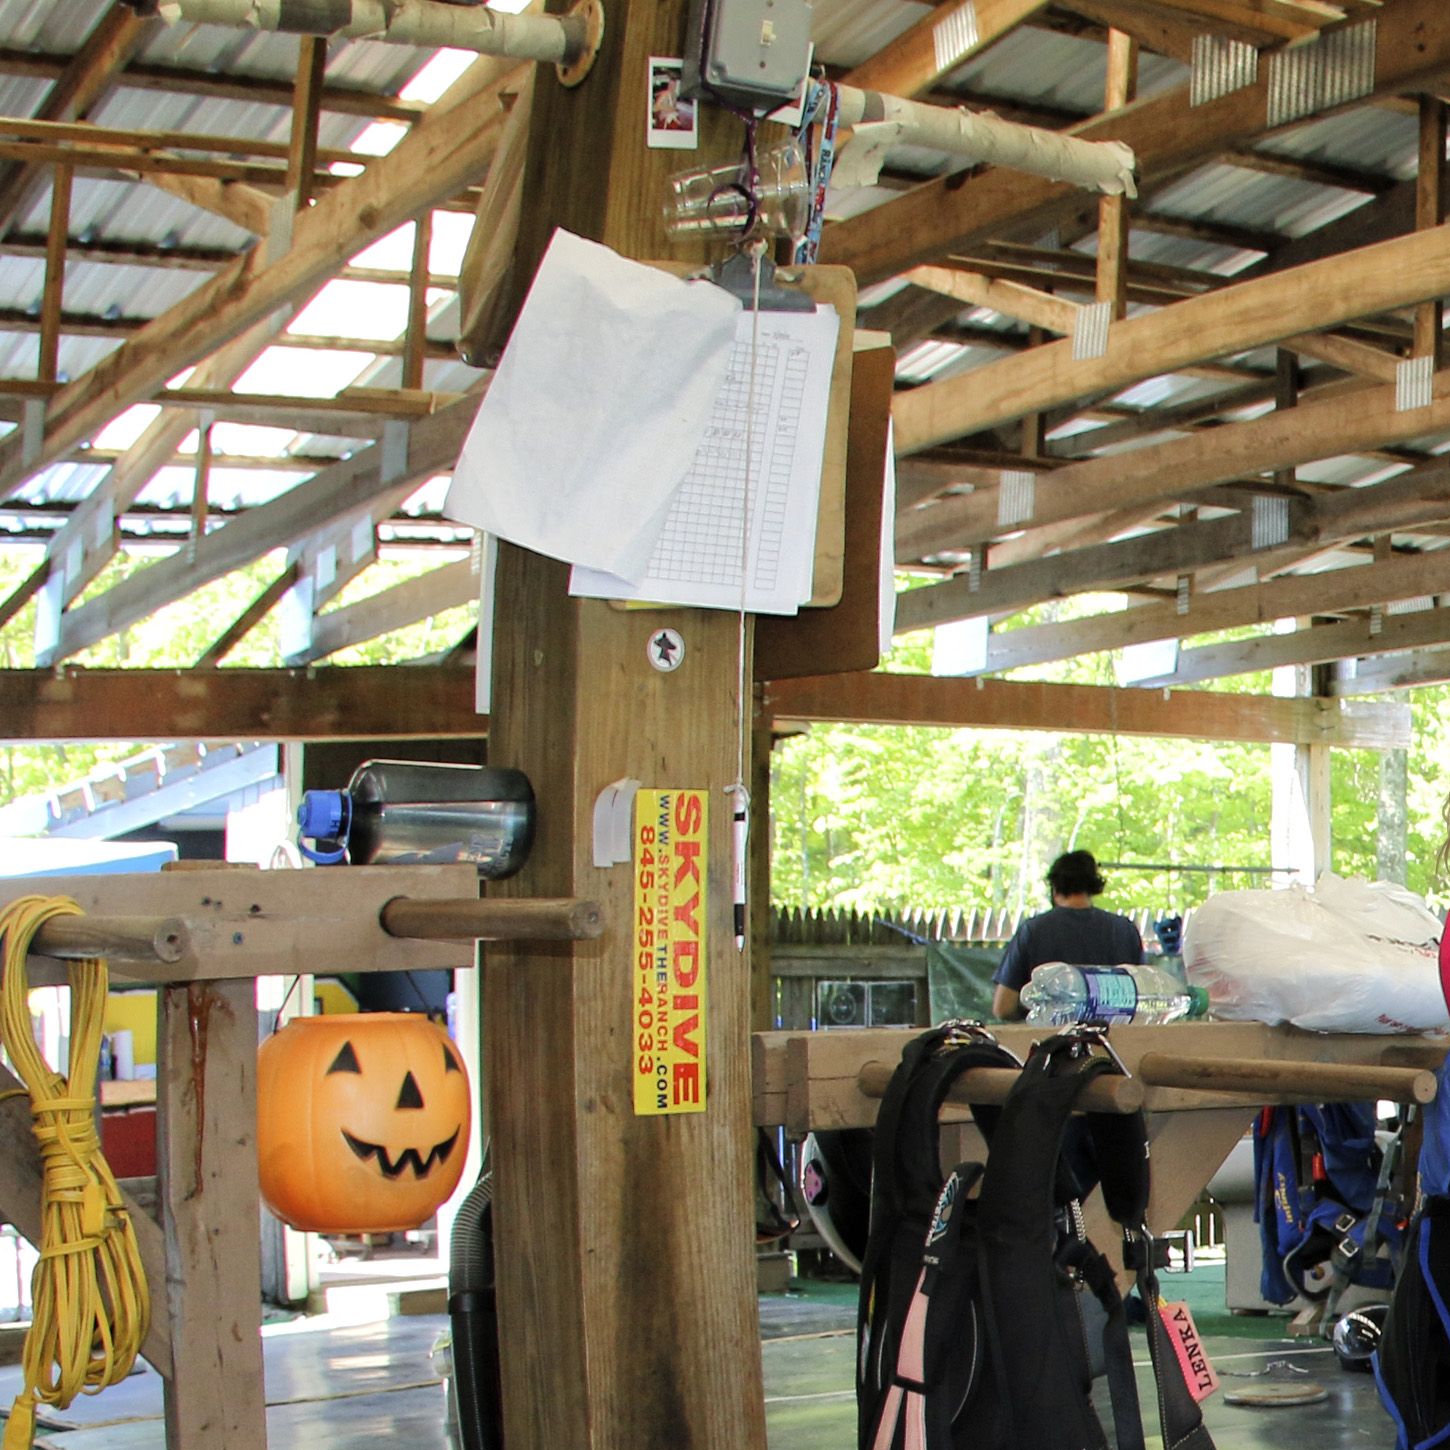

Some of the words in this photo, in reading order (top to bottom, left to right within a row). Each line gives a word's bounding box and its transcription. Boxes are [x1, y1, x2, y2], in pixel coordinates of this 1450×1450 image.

[638, 825, 655, 1075] 845-255-4033
[673, 793, 701, 1105] SKYDIVE
[1173, 1307, 1213, 1392] LENKA
